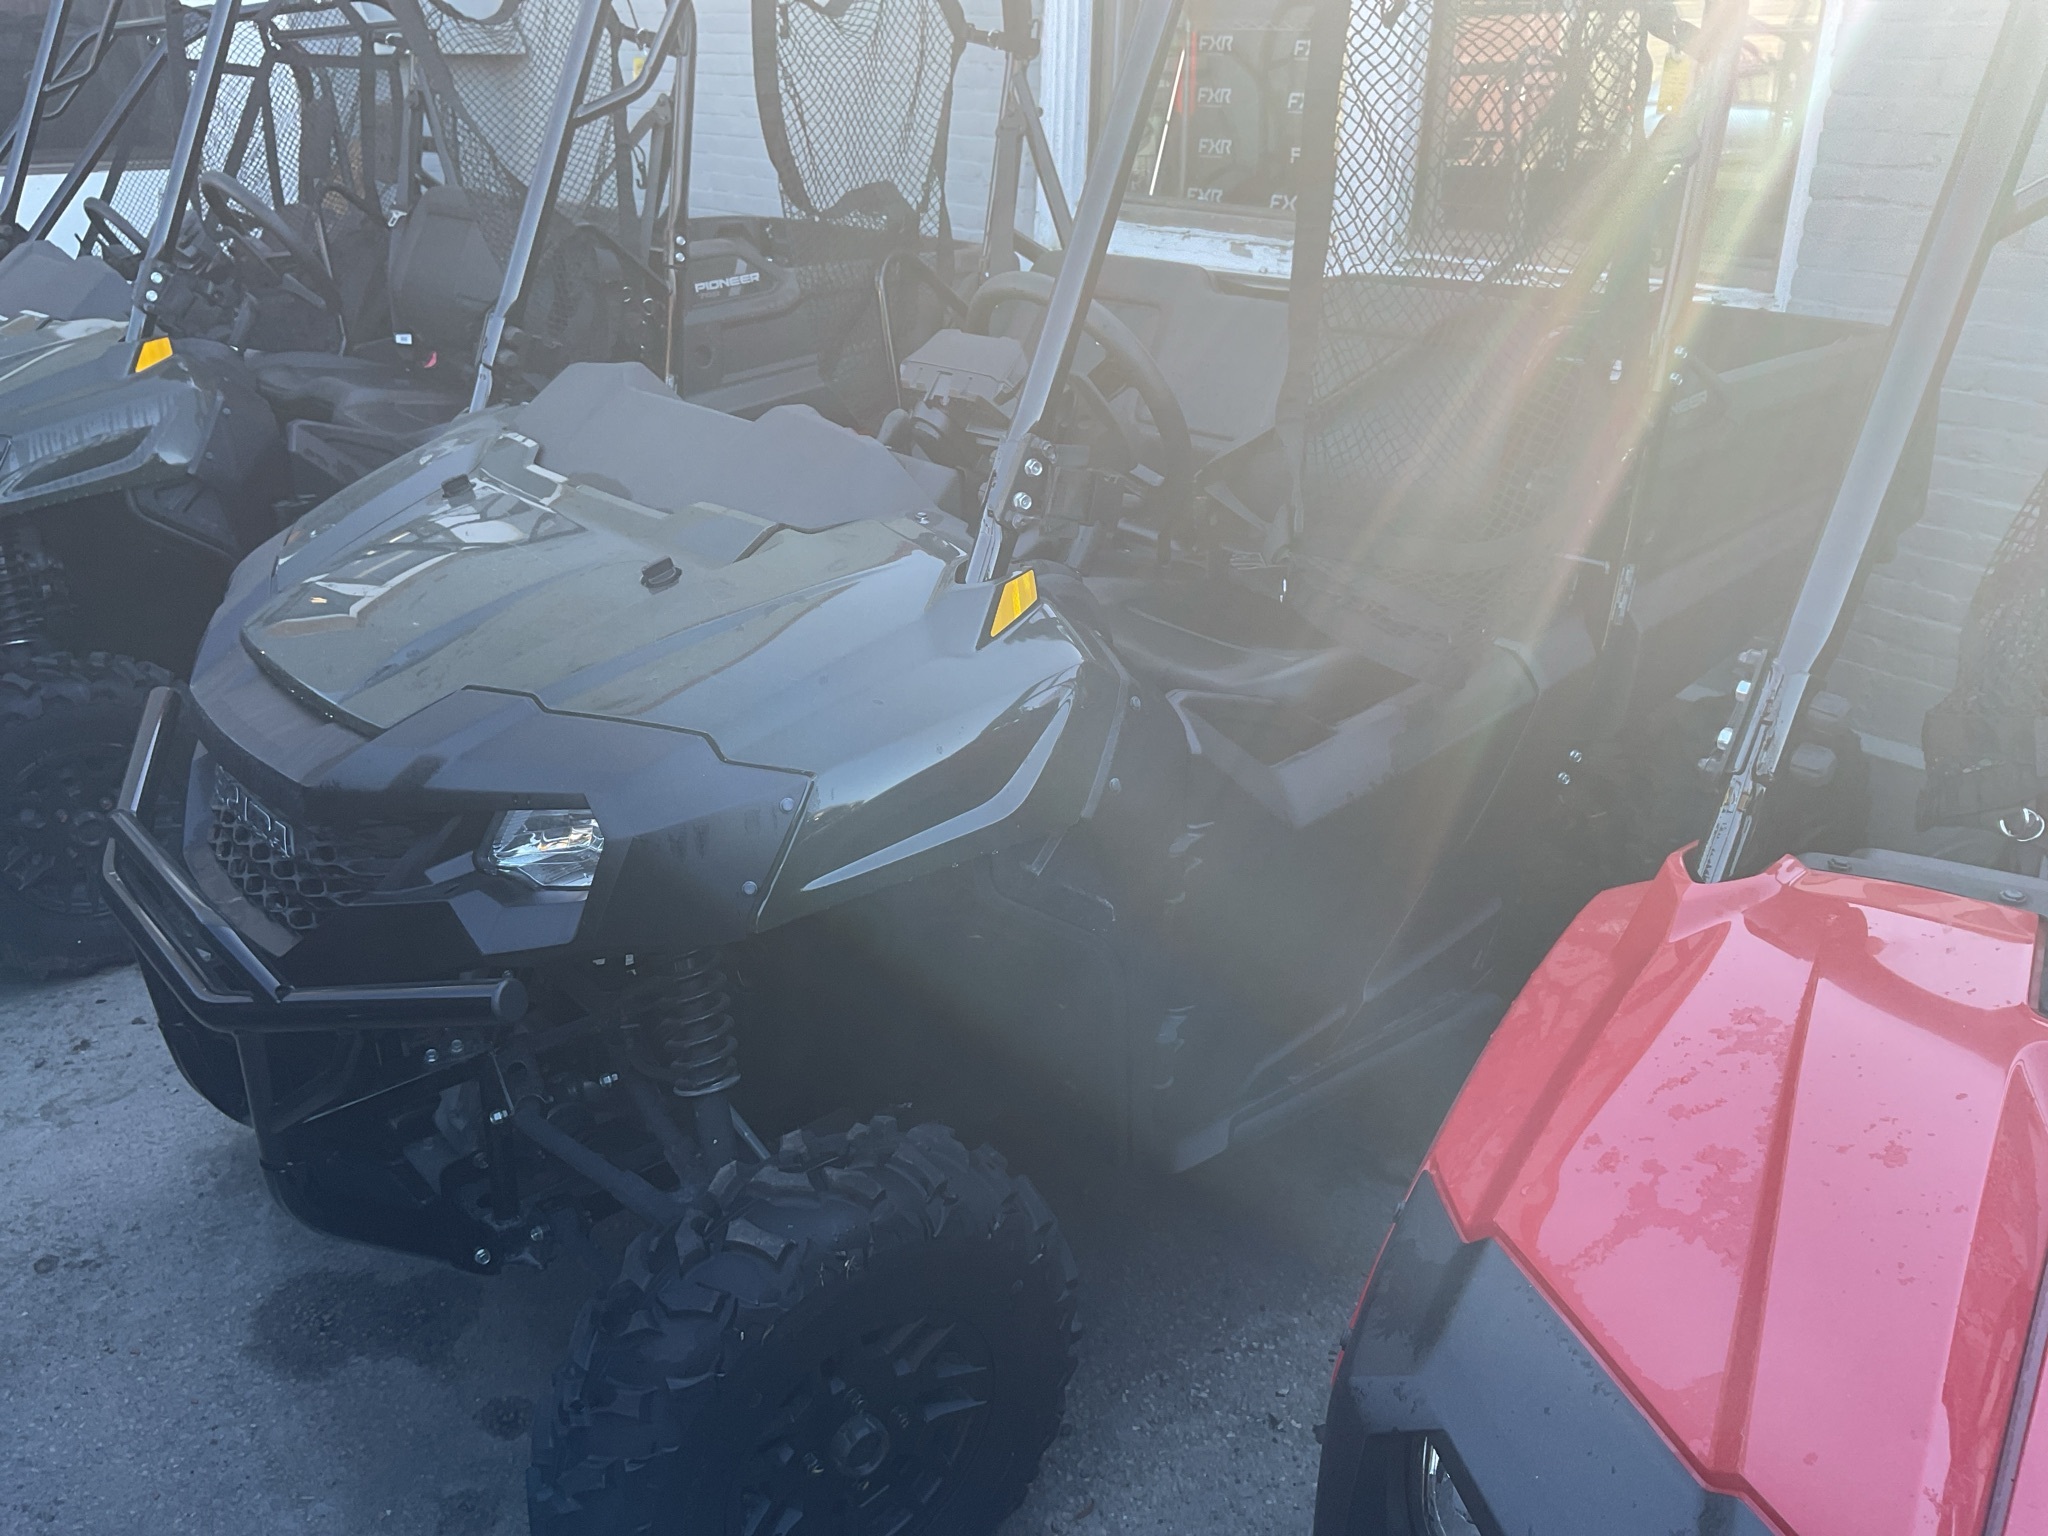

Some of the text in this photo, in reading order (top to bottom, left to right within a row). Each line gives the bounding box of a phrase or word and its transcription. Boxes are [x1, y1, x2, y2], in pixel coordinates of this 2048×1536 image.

[1199, 36, 1233, 51] FXR
[1198, 88, 1231, 104] FXR
[1199, 139, 1232, 154] FXR
[1187, 188, 1223, 203] FXR
[694, 272, 760, 293] PIONEER
